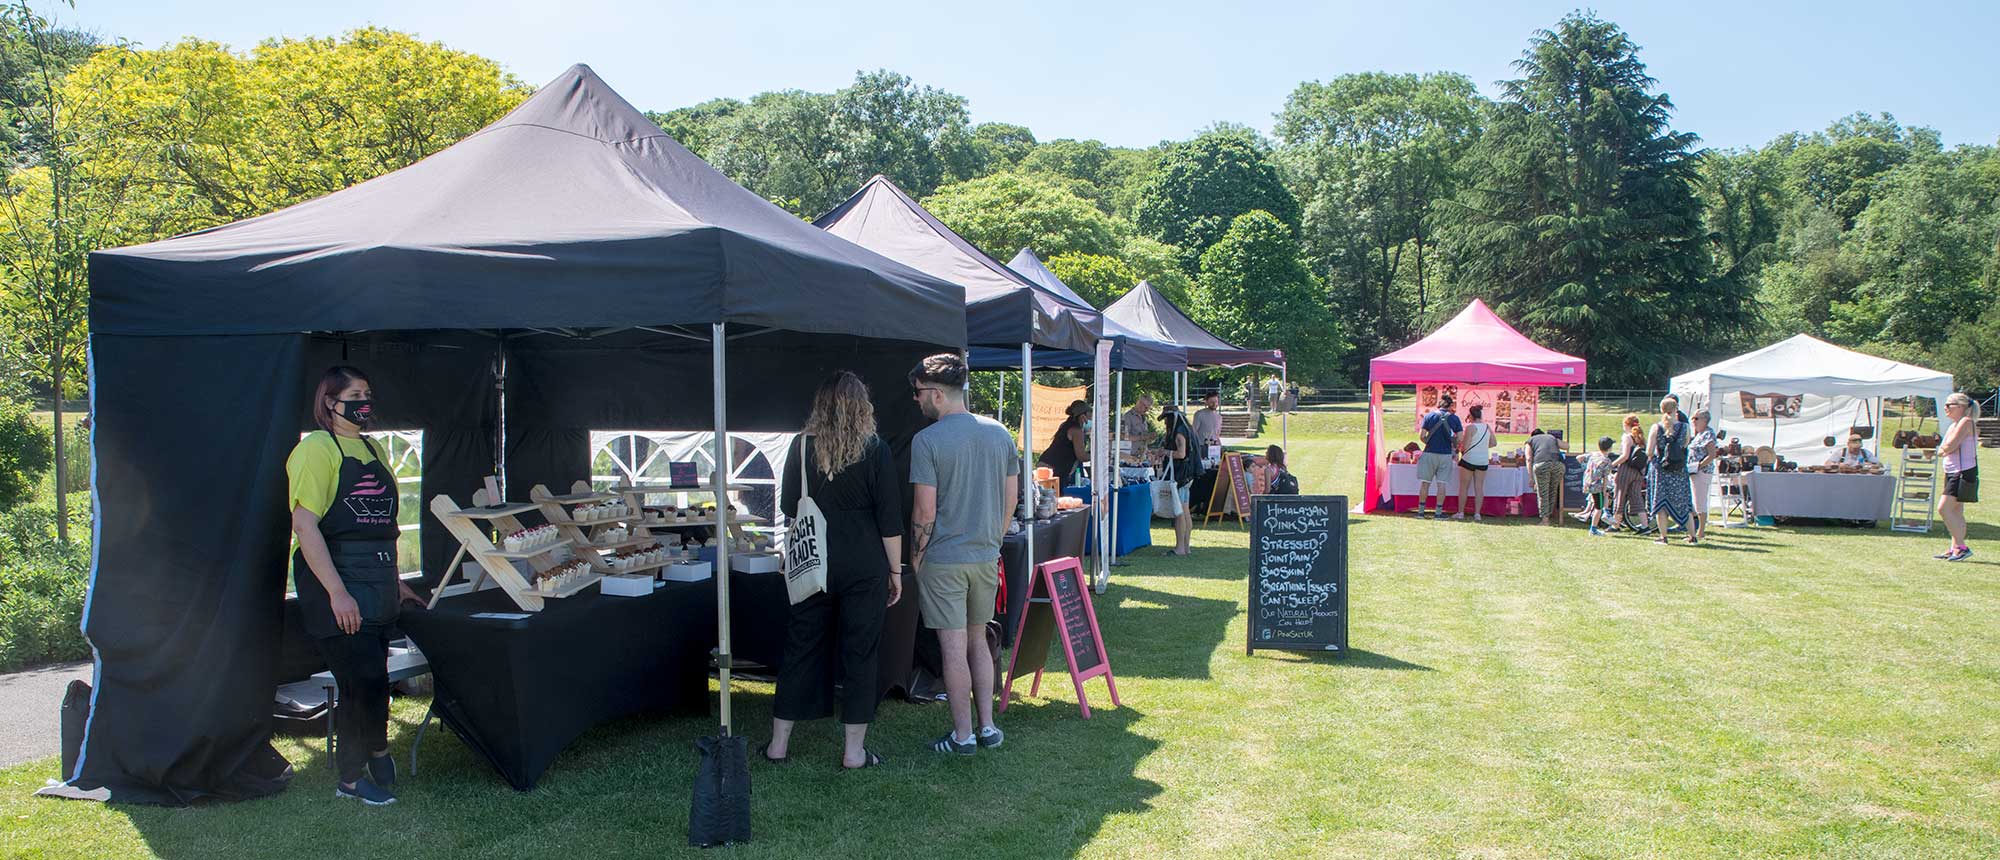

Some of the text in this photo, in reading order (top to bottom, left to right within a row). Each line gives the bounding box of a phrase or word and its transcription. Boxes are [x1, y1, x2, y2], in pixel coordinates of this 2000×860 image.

[1267, 503, 1328, 517] HIMALAYAN
[1264, 516, 1329, 533] PINK SALT
[1261, 532, 1328, 551] STRESSED?
[789, 538, 819, 570] TRADE
[1261, 551, 1289, 566] JOINT
[1260, 579, 1338, 595] BREATHING ISSUES
[1288, 592, 1329, 608] SLEEP?
[1277, 607, 1309, 618] NATURAL
